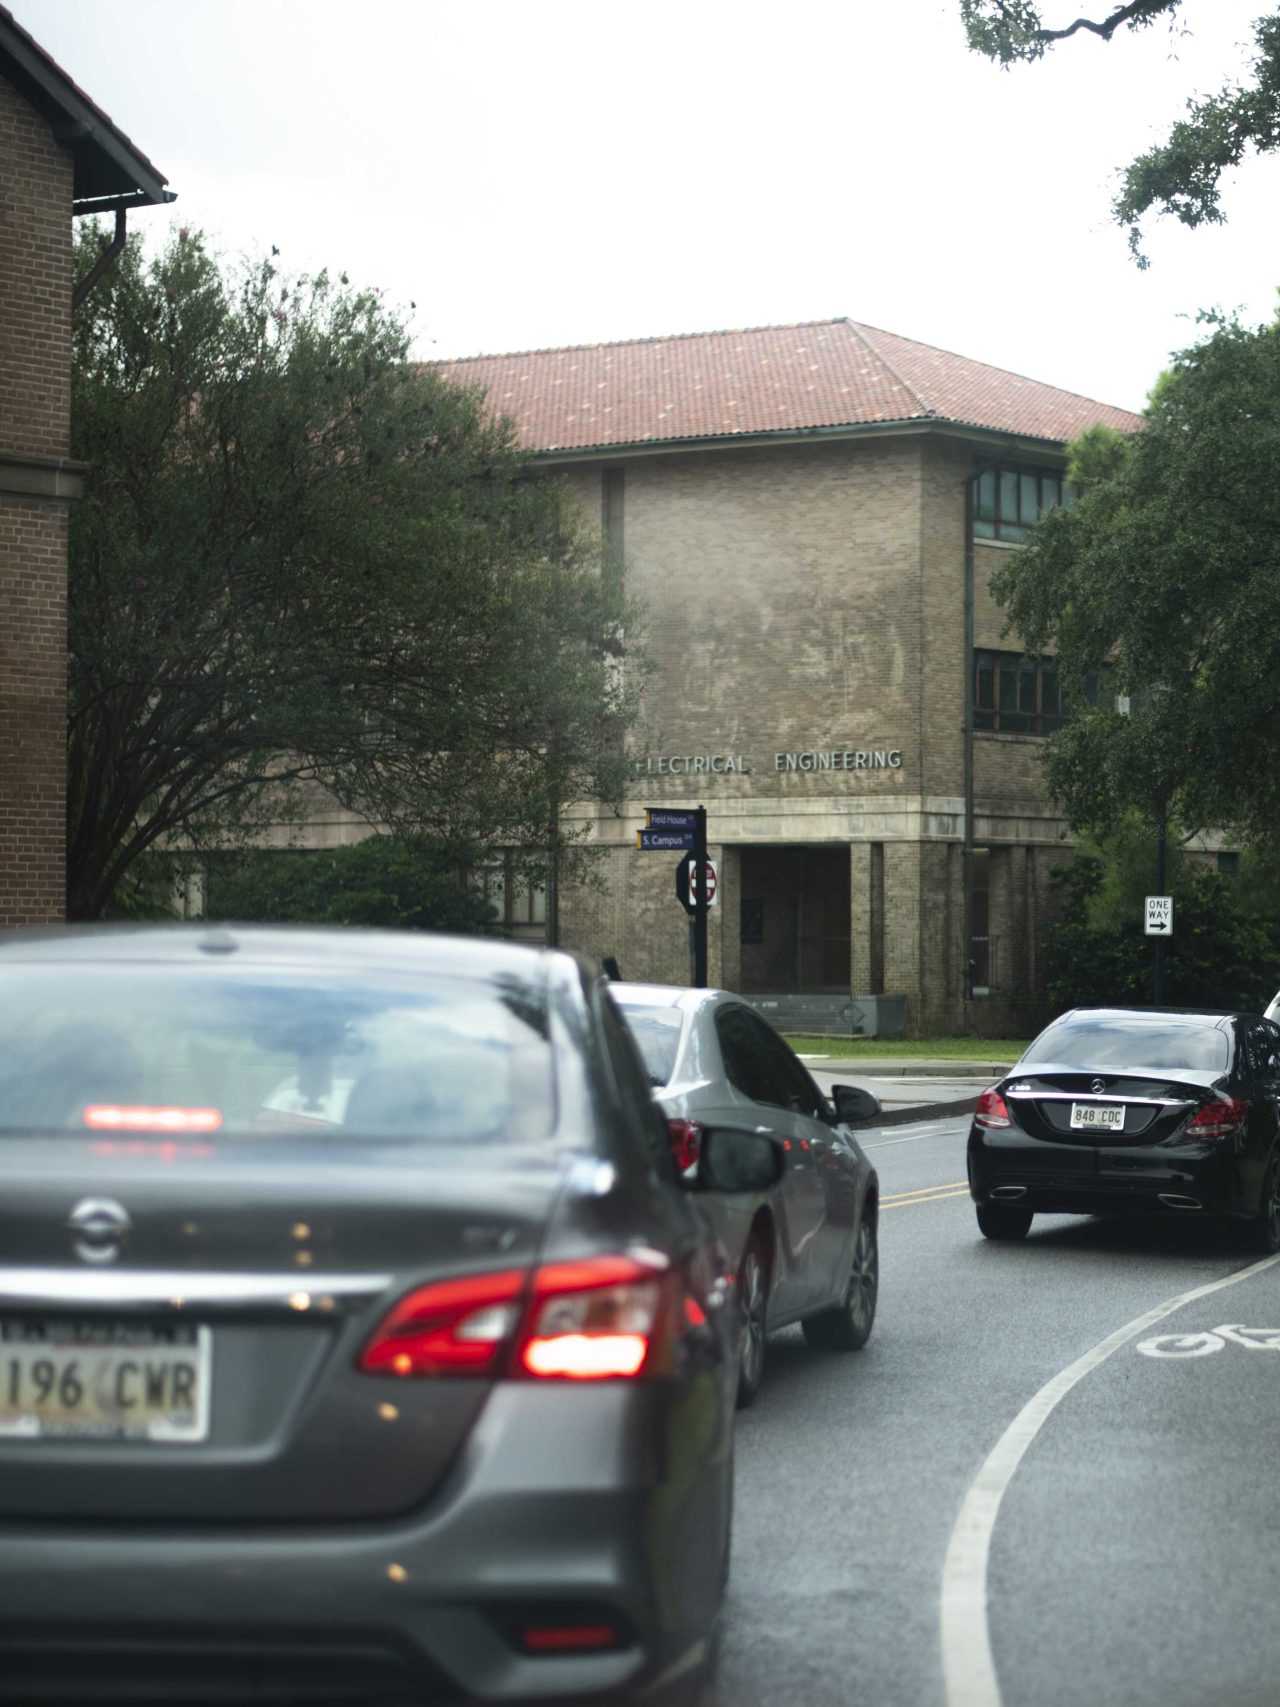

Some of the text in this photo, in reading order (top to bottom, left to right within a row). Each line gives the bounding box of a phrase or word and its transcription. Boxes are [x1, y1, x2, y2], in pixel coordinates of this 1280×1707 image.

[775, 750, 901, 771] ENGINEERING
[652, 835, 683, 847] Campus
[1149, 900, 1169, 909] ONE
[1149, 910, 1169, 920] WAY
[9, 1358, 196, 1409] 196 CWR
